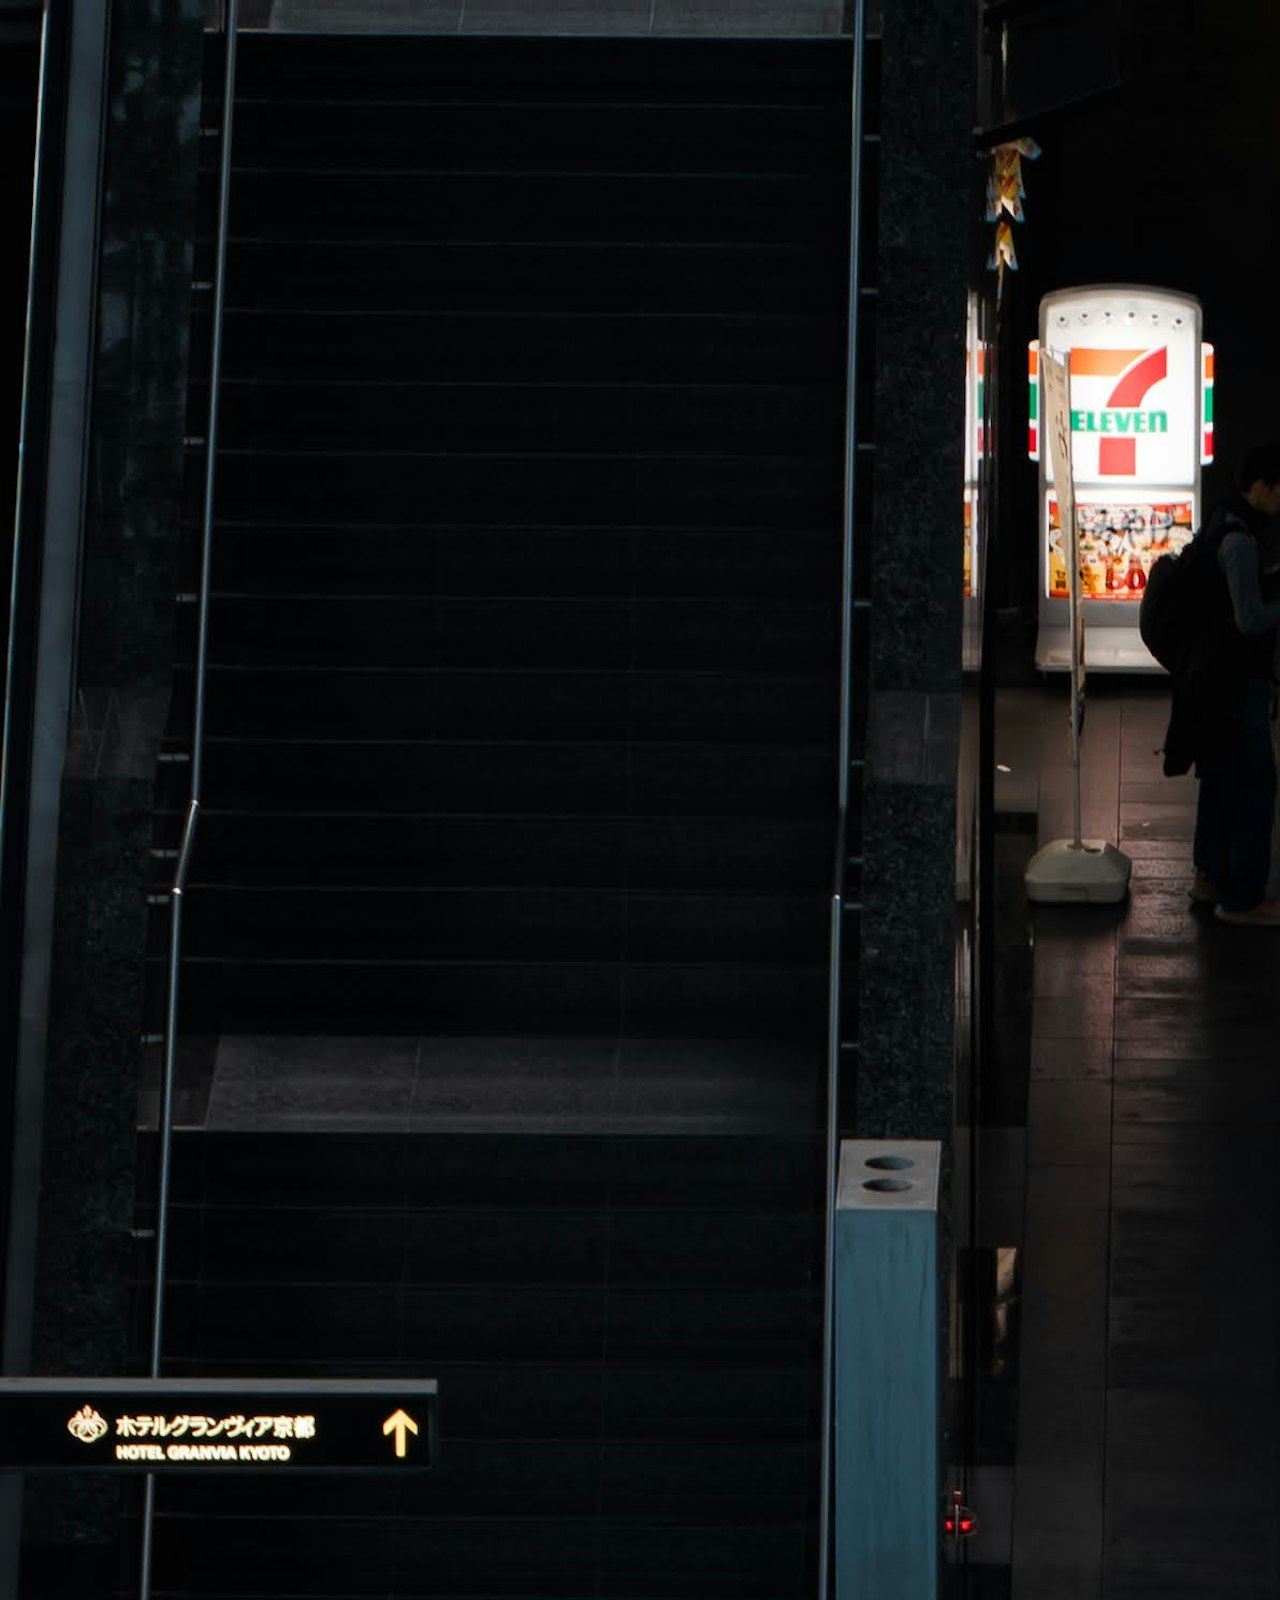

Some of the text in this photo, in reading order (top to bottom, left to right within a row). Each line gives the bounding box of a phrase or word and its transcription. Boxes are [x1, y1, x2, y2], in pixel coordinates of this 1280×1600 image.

[115, 1415, 316, 1438] ホテルグランヴィア京都
[115, 1444, 291, 1461] HOTEL GRANVIA KYOTO
